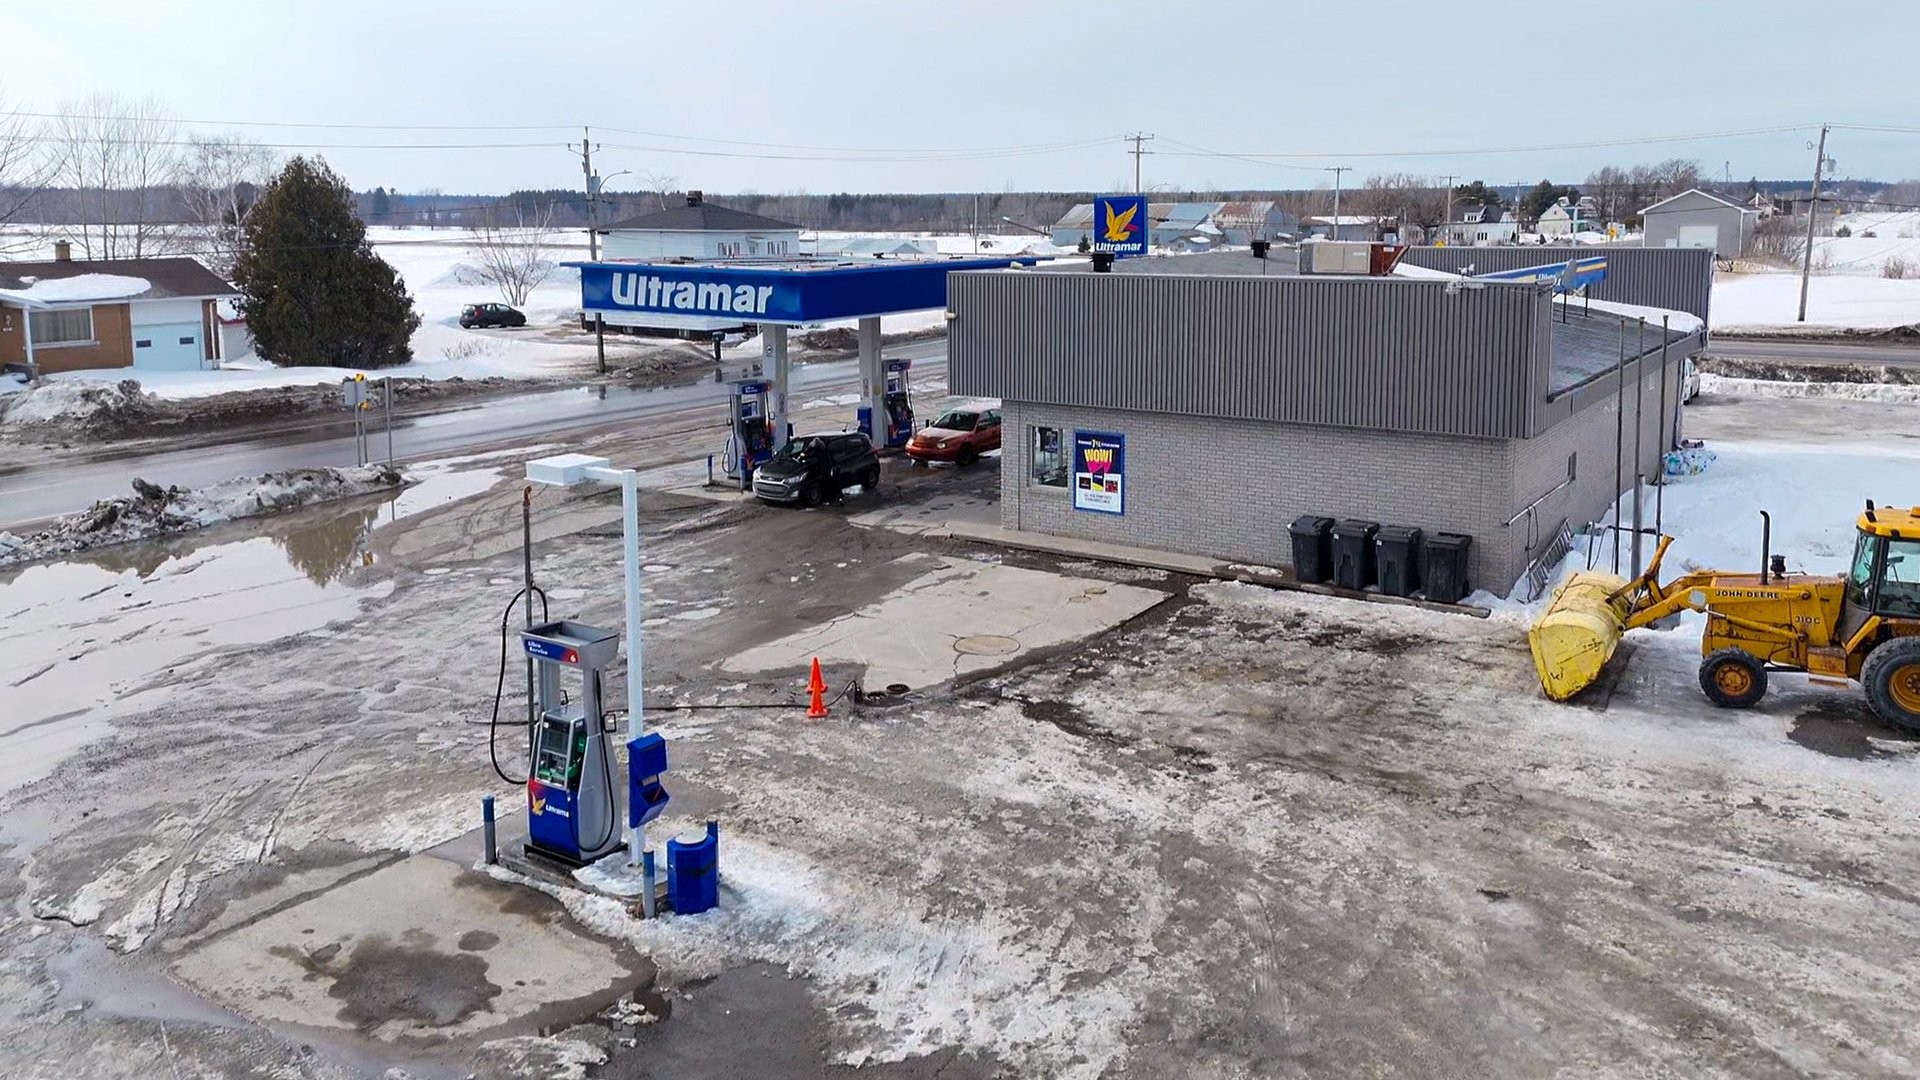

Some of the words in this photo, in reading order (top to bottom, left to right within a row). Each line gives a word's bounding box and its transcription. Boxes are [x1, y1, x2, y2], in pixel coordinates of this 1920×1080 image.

[1096, 242, 1141, 251] Ultramar
[611, 272, 773, 314] Ultramar
[1084, 449, 1112, 462] WOW!
[1715, 590, 1743, 598] JOHN
[1746, 591, 1781, 600] DEERE
[1795, 616, 1821, 625] 310C
[570, 654, 576, 662] 6
[545, 804, 569, 818] Ultrama
